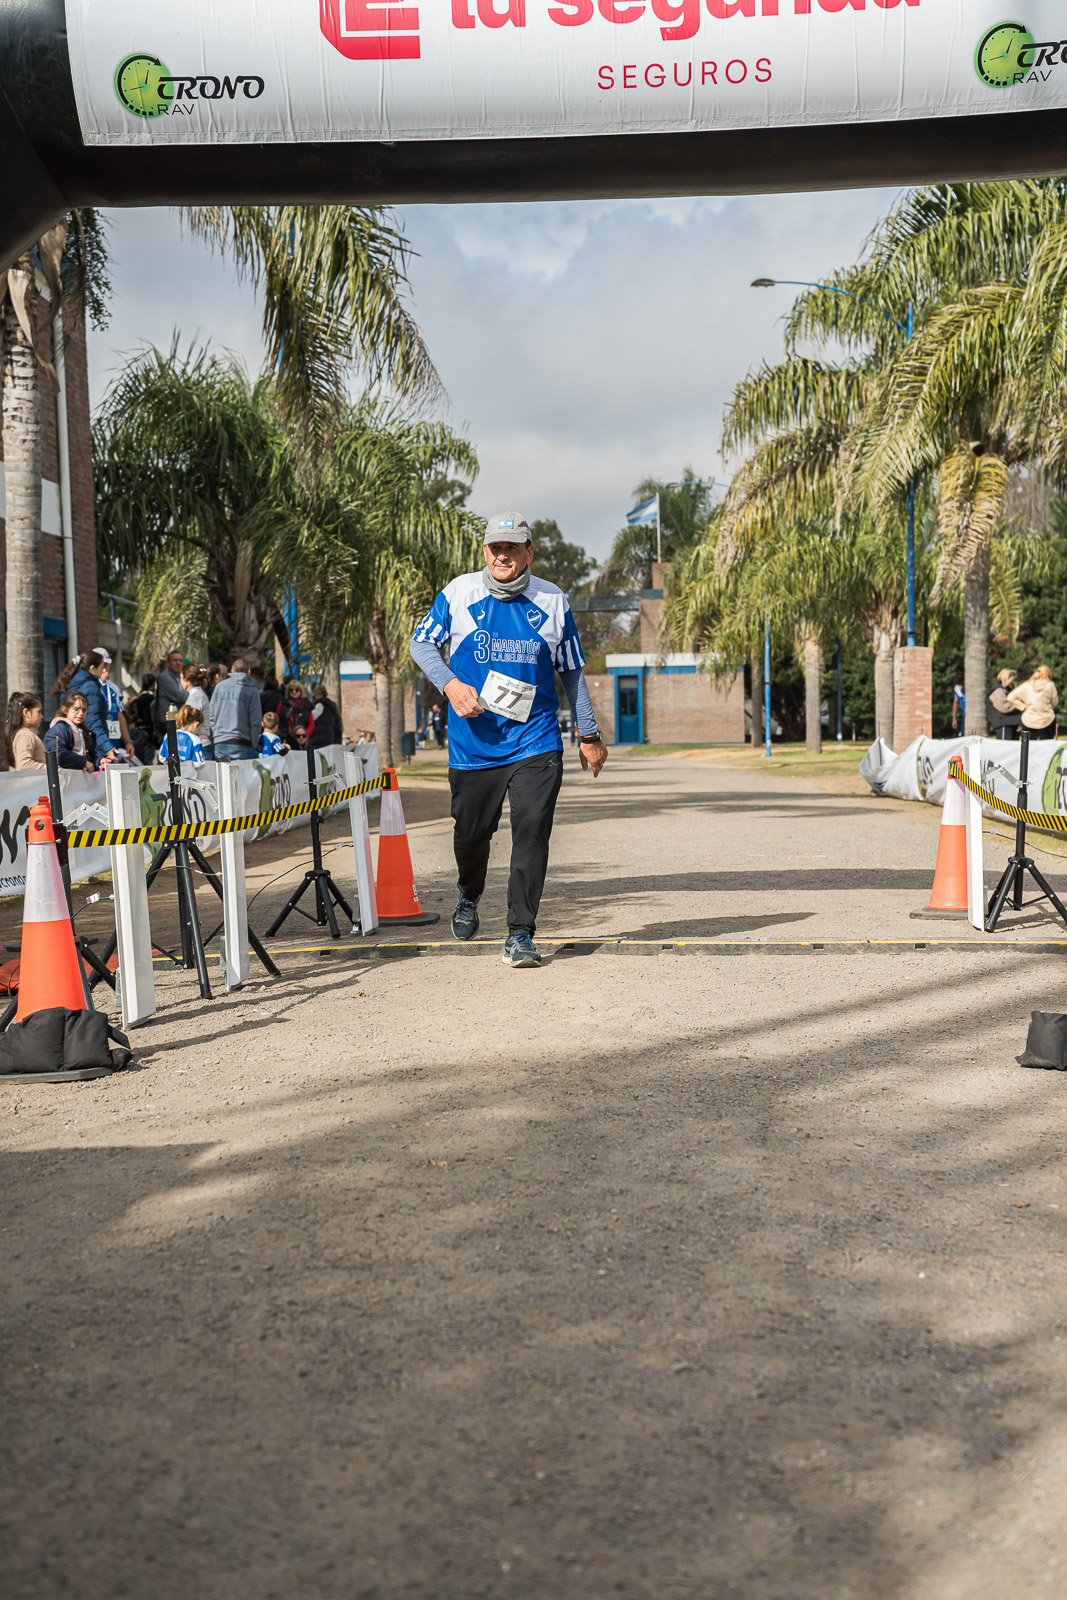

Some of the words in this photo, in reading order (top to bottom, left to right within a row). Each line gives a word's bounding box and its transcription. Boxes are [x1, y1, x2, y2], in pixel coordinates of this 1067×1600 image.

[597, 58, 772, 90] SEGUROS
[1013, 70, 1052, 84] RAV
[157, 75, 265, 99] CRONO
[157, 103, 195, 115] RAV
[474, 630, 490, 663] 3
[491, 638, 541, 655] MARATÓN
[494, 685, 523, 709] 77
[0, 874, 26, 892] crono
